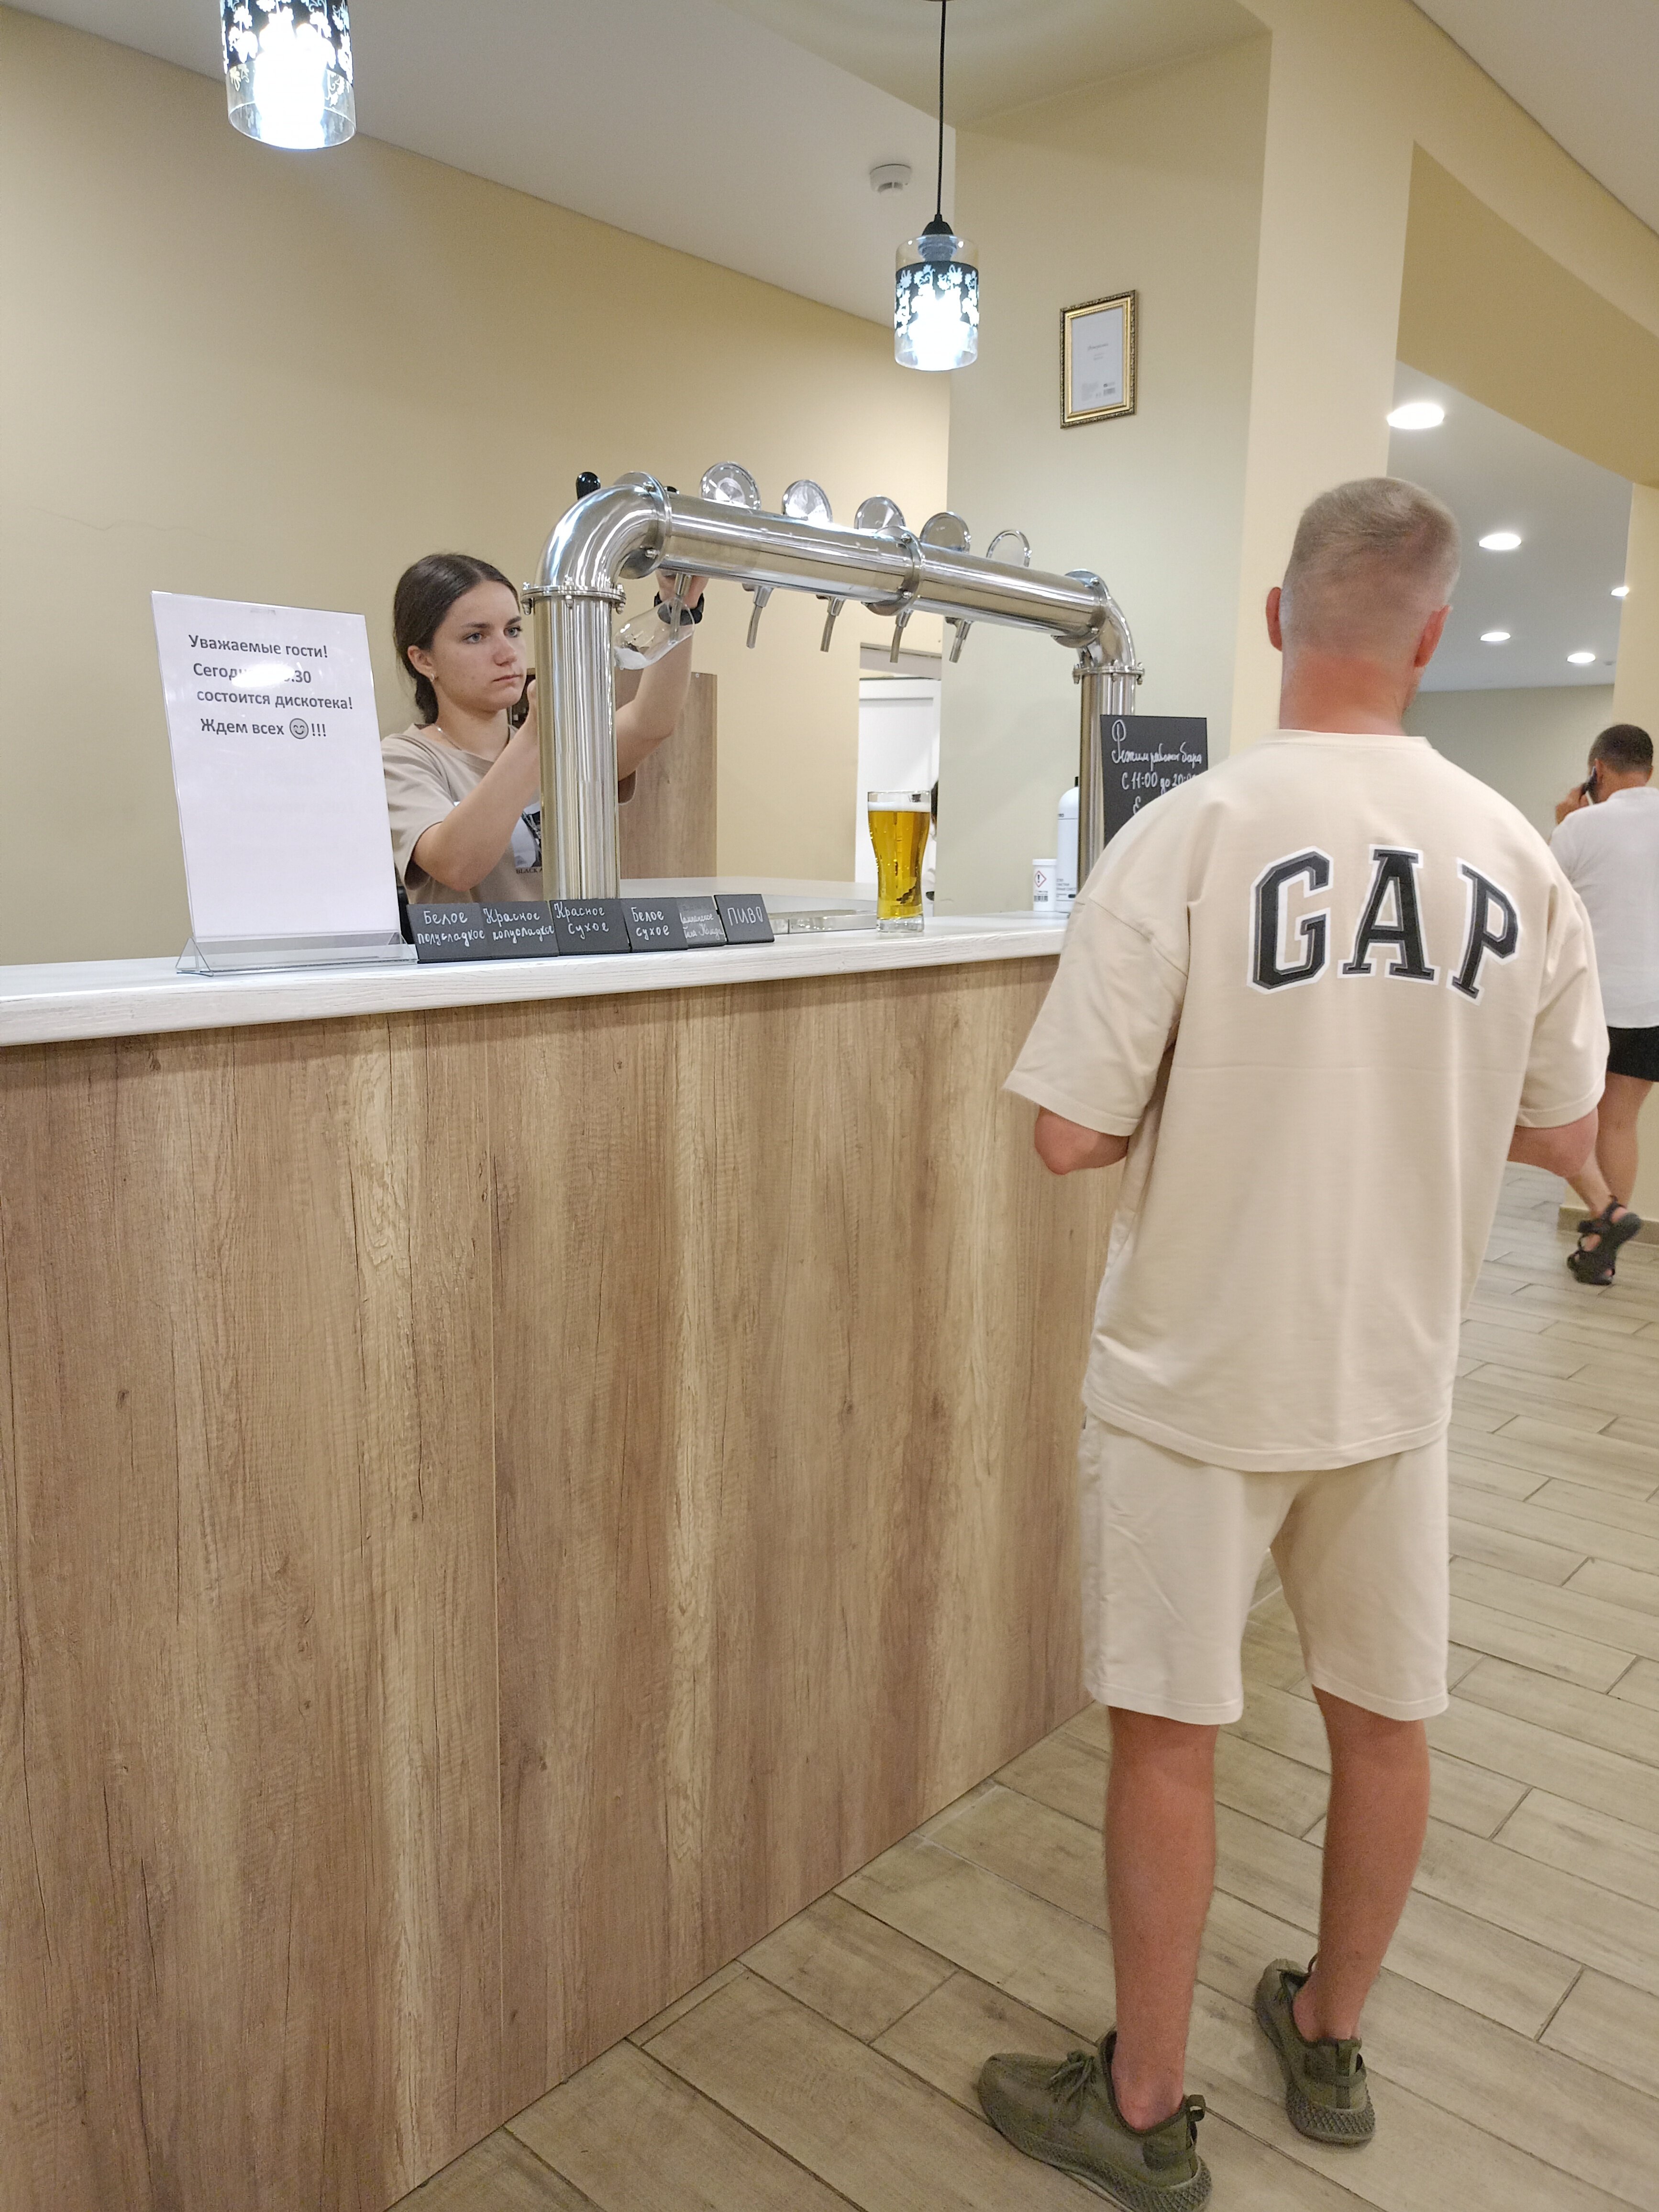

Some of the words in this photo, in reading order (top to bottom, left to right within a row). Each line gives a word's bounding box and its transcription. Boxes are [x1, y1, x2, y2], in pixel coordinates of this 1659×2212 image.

[188, 635, 281, 654] Уважаемые
[286, 645, 328, 658] гости!
[193, 663, 248, 681] Сегод
[197, 690, 270, 705] состоится
[275, 695, 353, 709] дискотека!
[200, 718, 248, 737] Ждем
[253, 722, 285, 735] всех
[1180, 741, 1202, 769] бара
[1131, 771, 1158, 790] 11:00
[423, 910, 468, 925] Белое
[483, 908, 541, 927] Красное
[554, 902, 605, 922] Красное
[630, 907, 664, 922] Белое
[1247, 844, 1523, 1006] GAP
[417, 929, 485, 947] полусладкое
